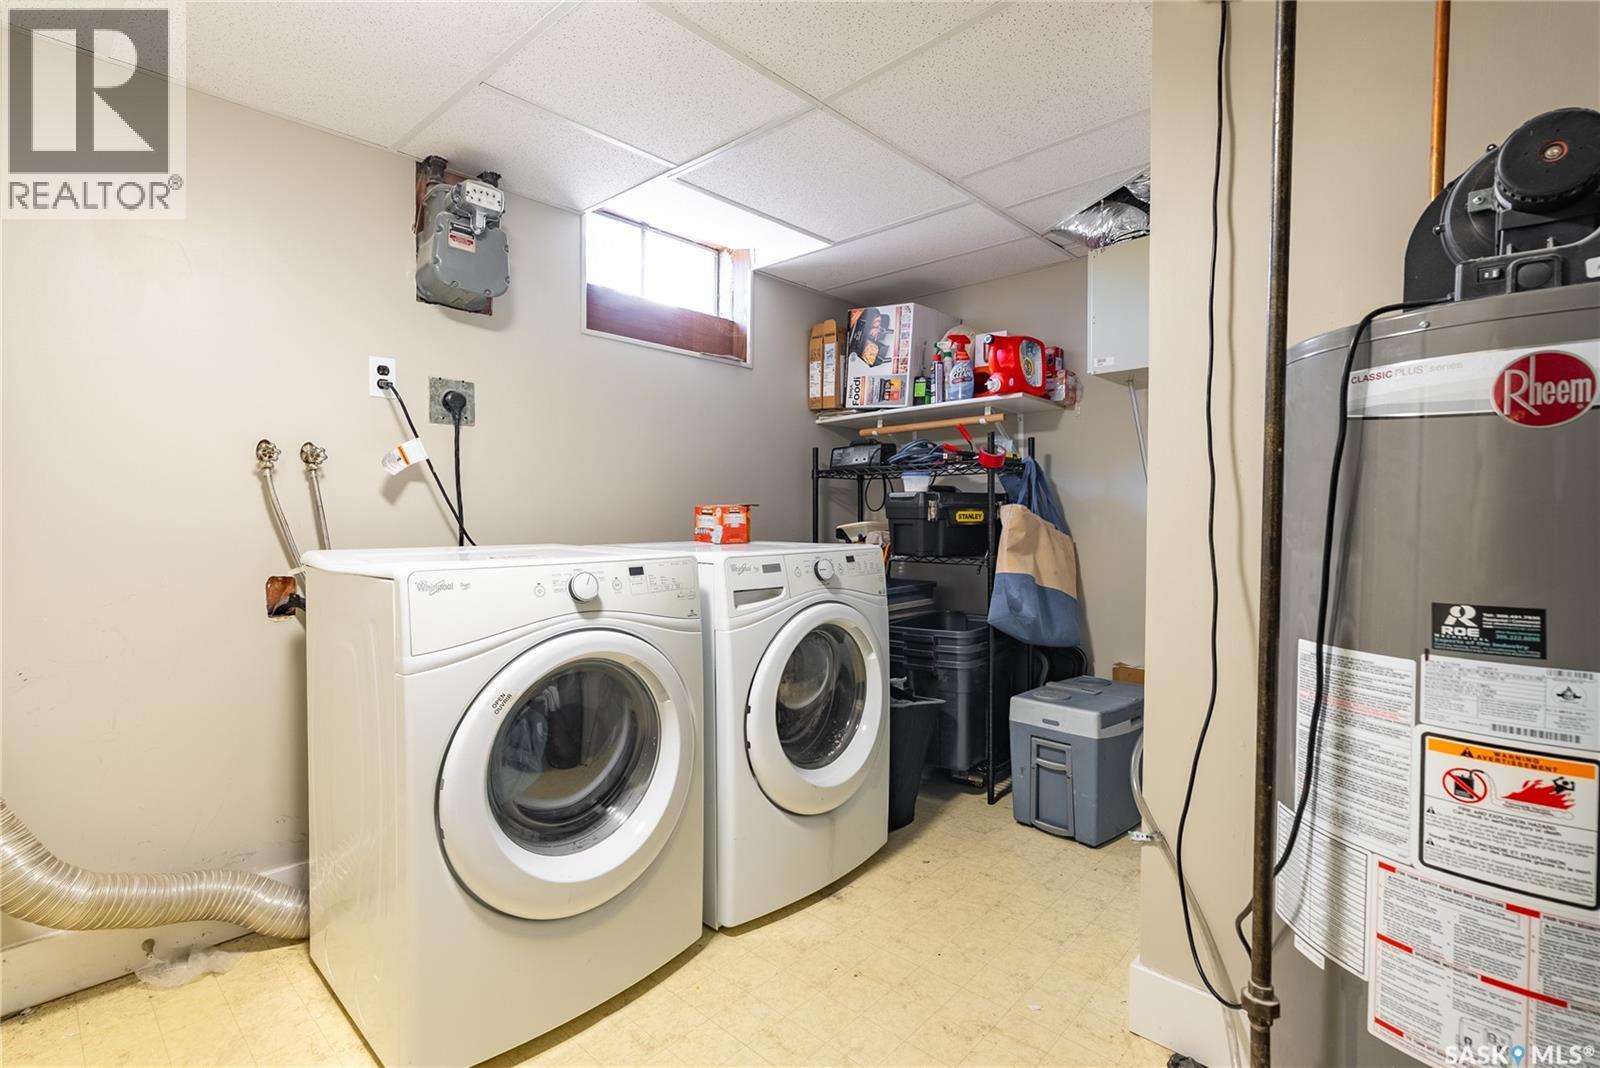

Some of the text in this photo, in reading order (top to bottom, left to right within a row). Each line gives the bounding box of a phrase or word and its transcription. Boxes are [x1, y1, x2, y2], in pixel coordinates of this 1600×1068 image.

[1350, 370, 1393, 384] CLASSIC
[1430, 362, 1464, 373] series
[852, 376, 861, 406] Foodi
[1504, 355, 1591, 416] Rheem
[1441, 626, 1480, 638] ROE
[492, 692, 506, 708] OPEN
[494, 694, 512, 714] OUVRIR
[1476, 754, 1558, 773] AVERTISSEMENT
[1493, 752, 1540, 764] WARNING
